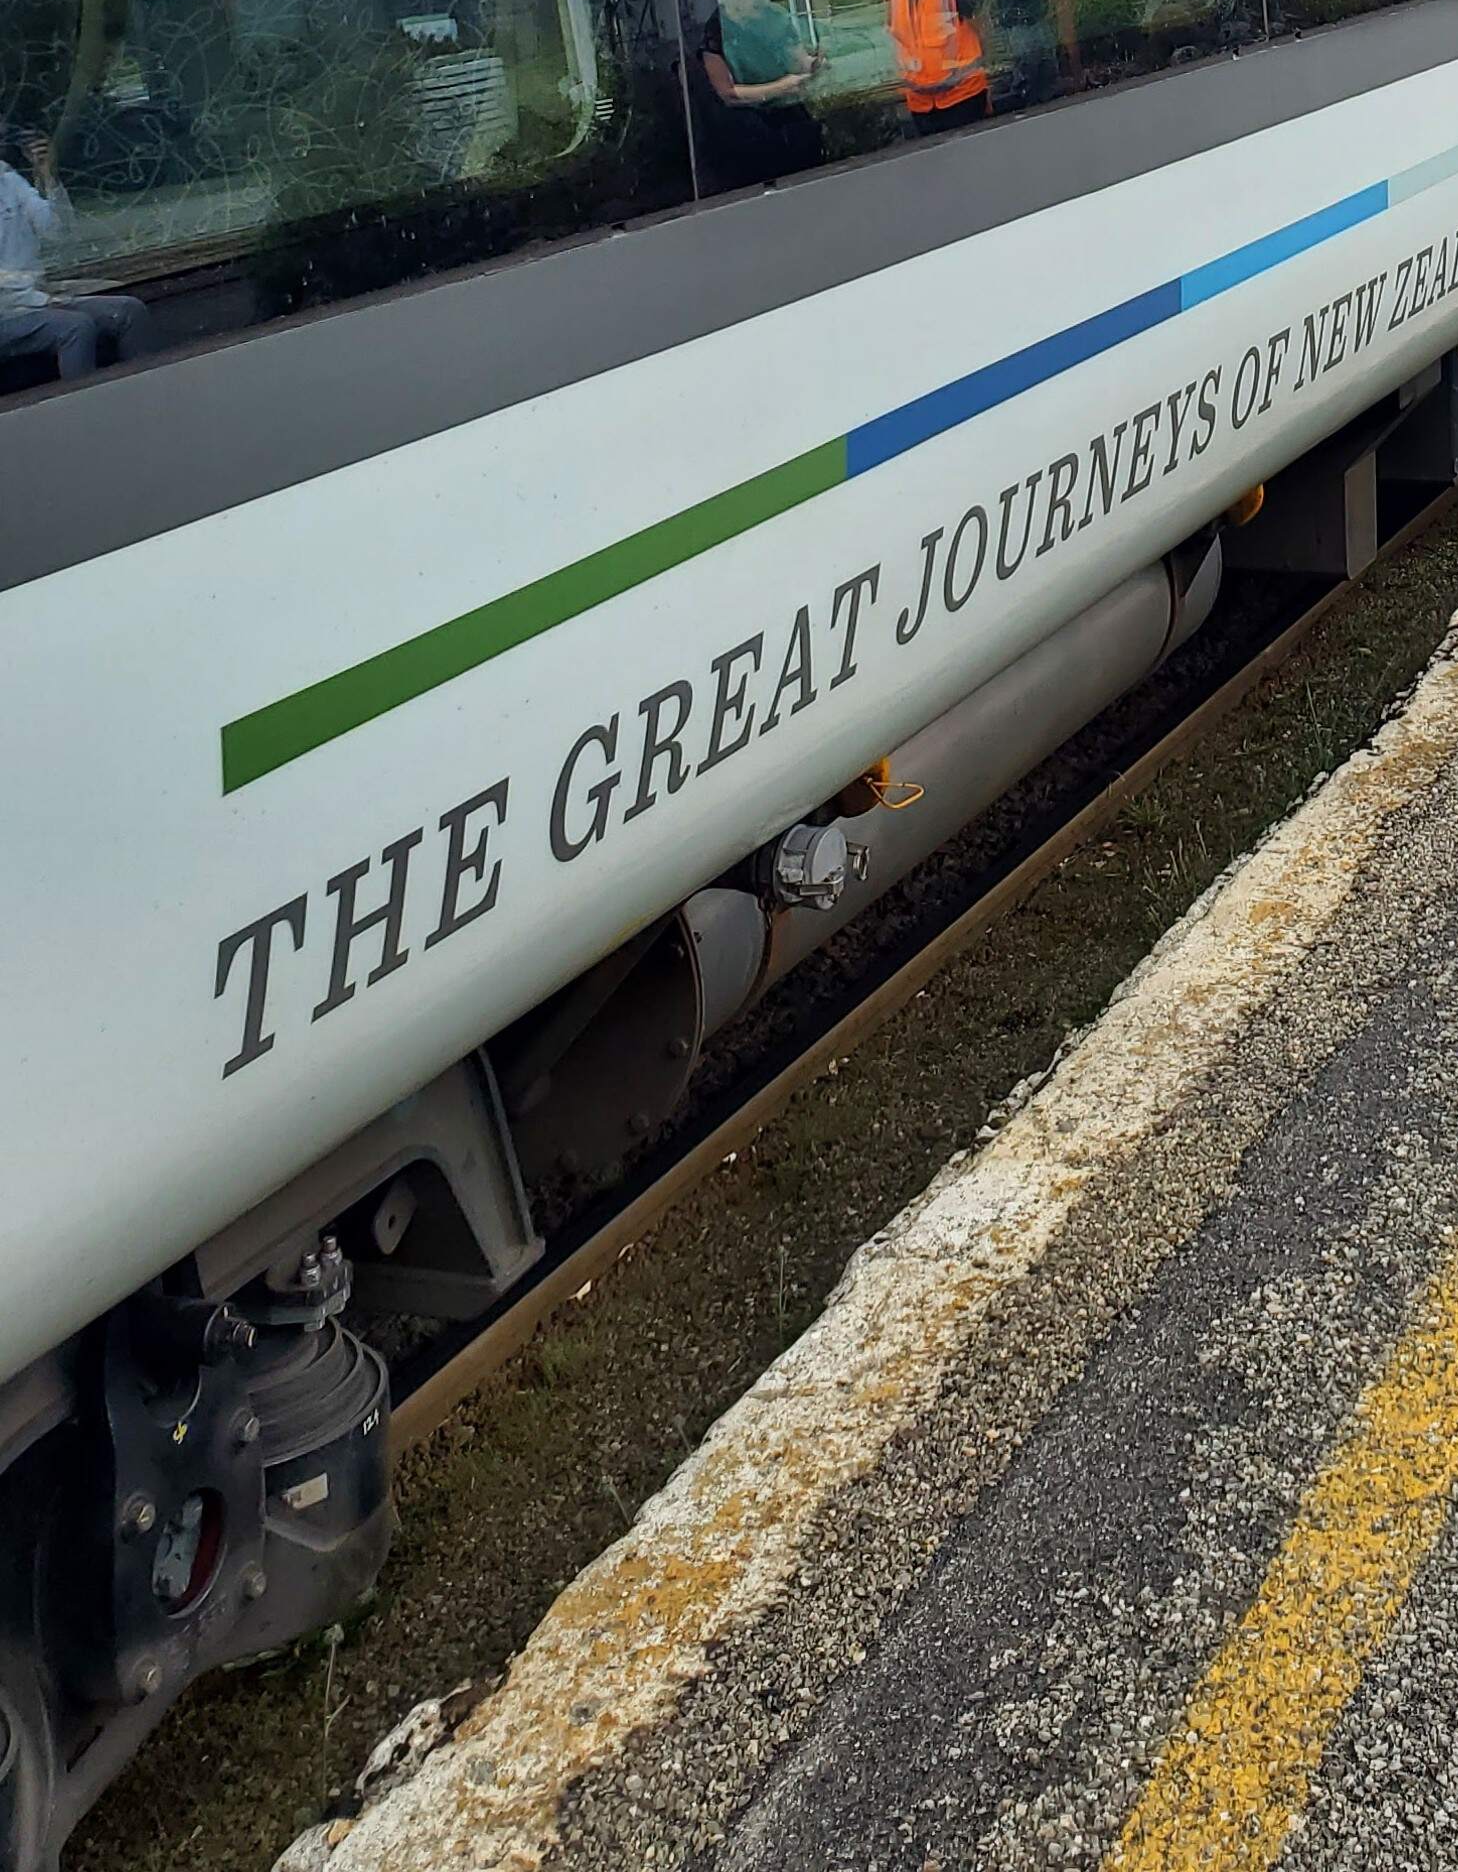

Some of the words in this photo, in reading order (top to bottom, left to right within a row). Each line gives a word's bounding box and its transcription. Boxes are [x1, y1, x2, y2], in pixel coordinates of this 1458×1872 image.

[213, 776, 510, 1081] THE
[549, 564, 881, 863] GREAT
[895, 365, 1222, 646] JOURNEYS
[1230, 327, 1291, 431] OF
[1293, 271, 1388, 393] NEW
